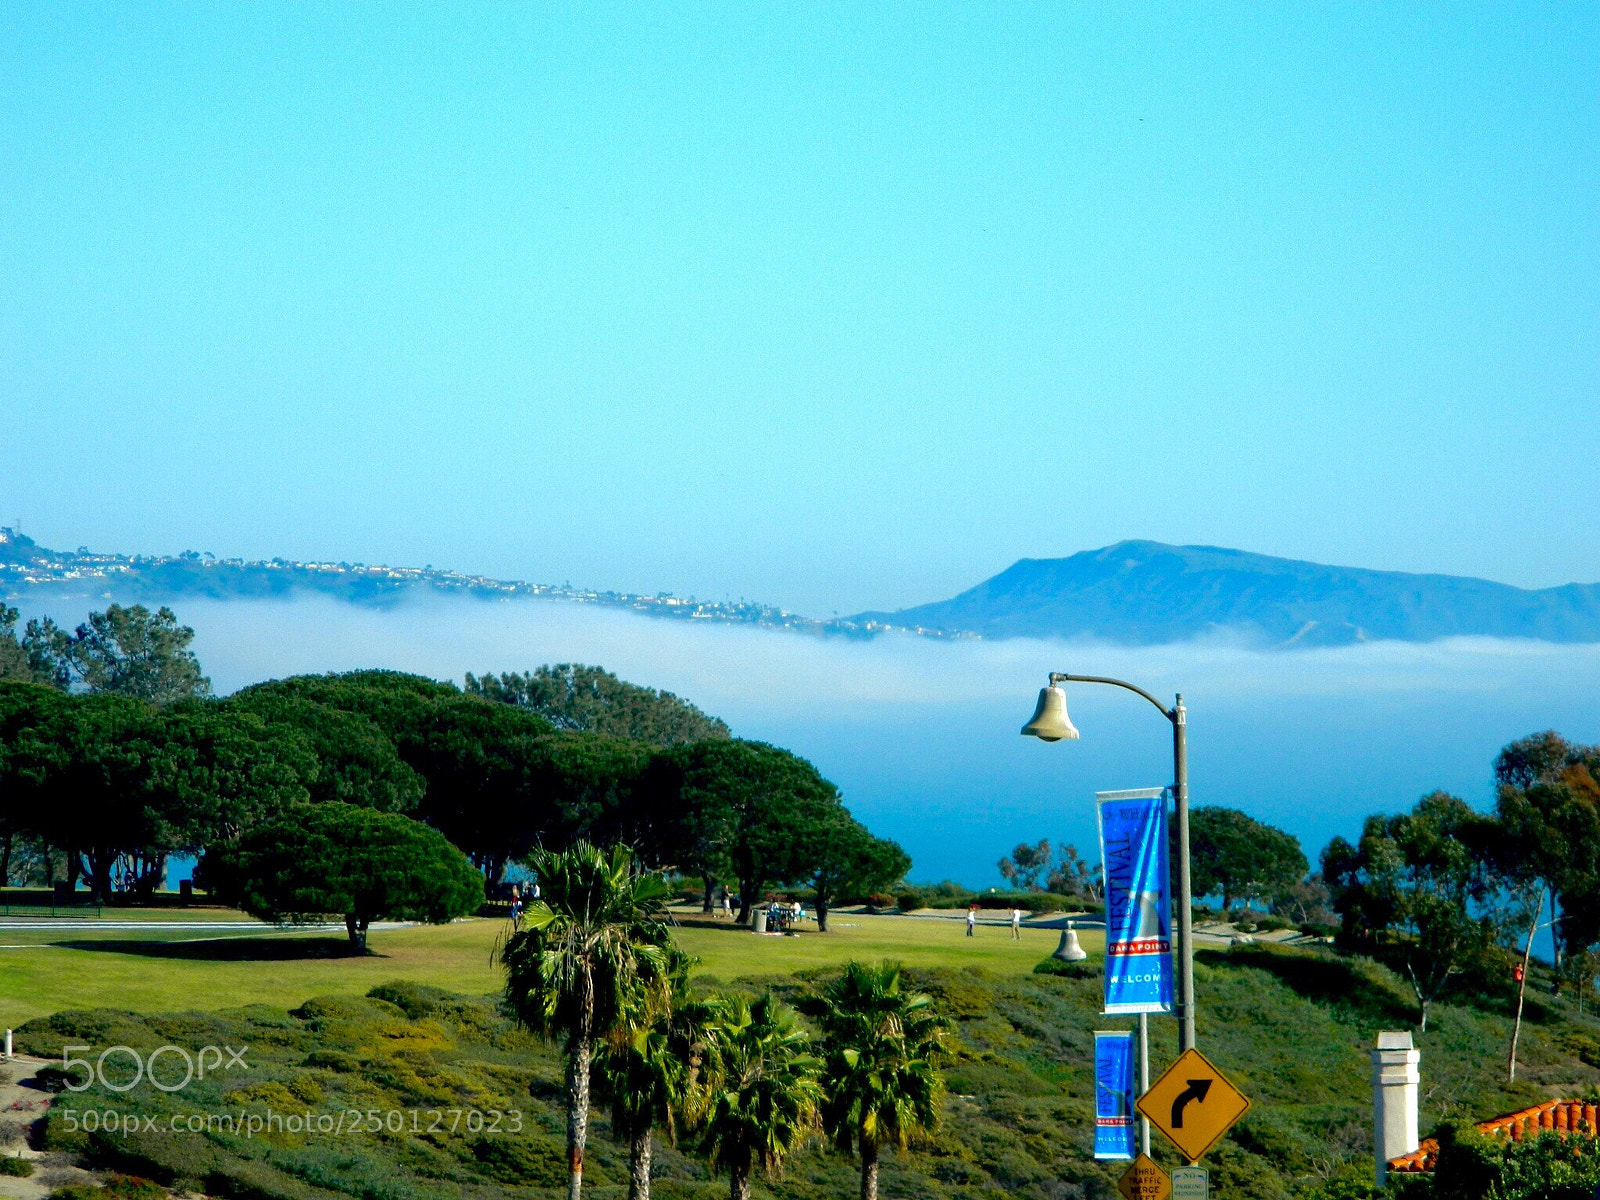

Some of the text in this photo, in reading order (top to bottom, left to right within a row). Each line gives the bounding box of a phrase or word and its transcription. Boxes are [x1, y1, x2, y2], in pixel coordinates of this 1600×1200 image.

[1107, 832, 1131, 933] FESTIVAL
[1109, 943, 1169, 953] DANA POINT
[1134, 1167, 1156, 1176] THRU
[1128, 1176, 1162, 1185] TRAFFIC
[1130, 1186, 1160, 1194] MERGE
